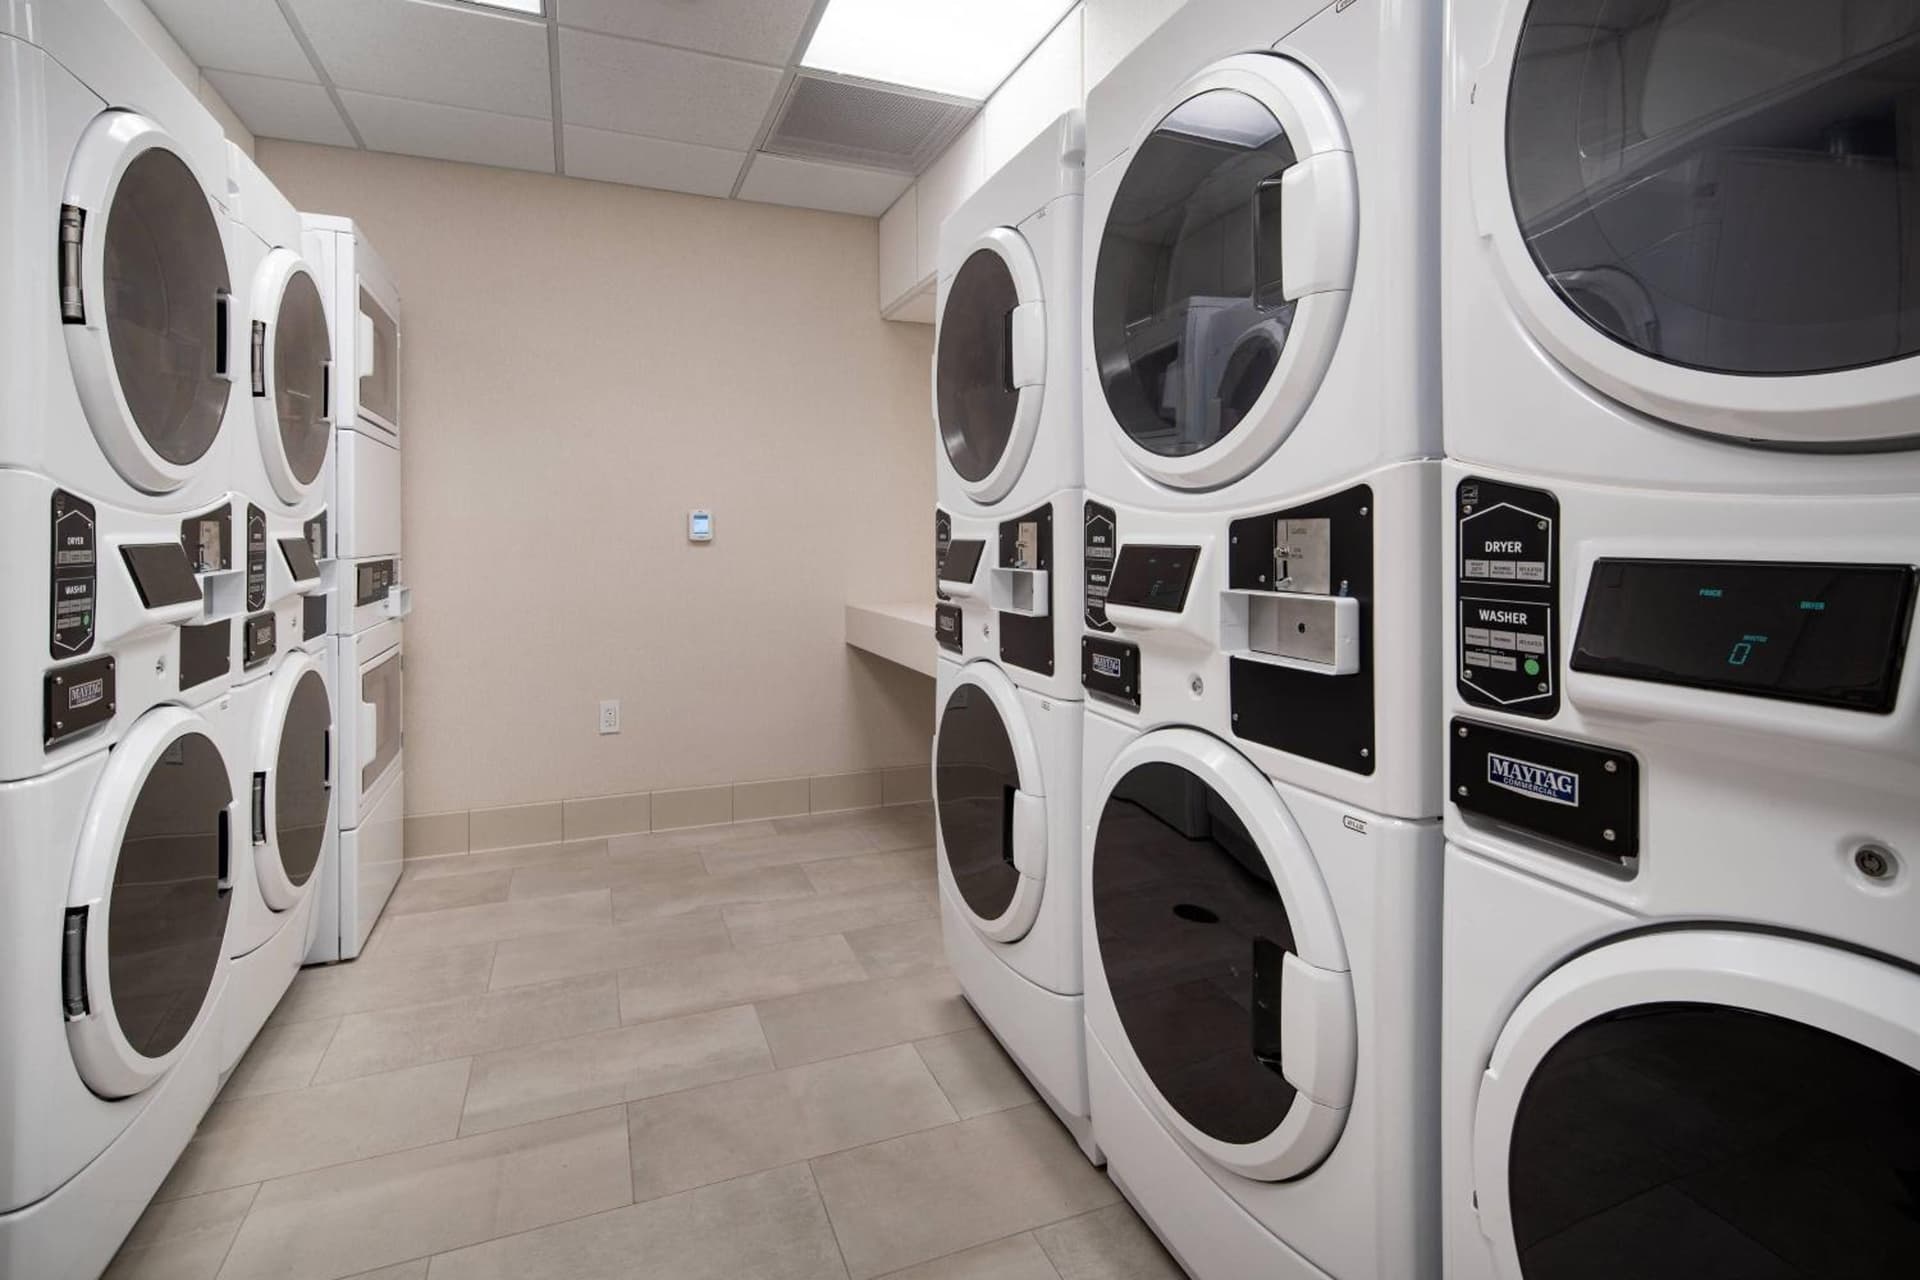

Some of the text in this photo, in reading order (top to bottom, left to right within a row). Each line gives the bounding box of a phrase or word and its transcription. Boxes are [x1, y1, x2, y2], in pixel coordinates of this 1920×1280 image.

[1485, 541, 1522, 553] DRYER
[1479, 608, 1528, 625] WASHER
[1492, 758, 1573, 794] MAYTAG
[1503, 777, 1557, 797] COMMERCIAL
